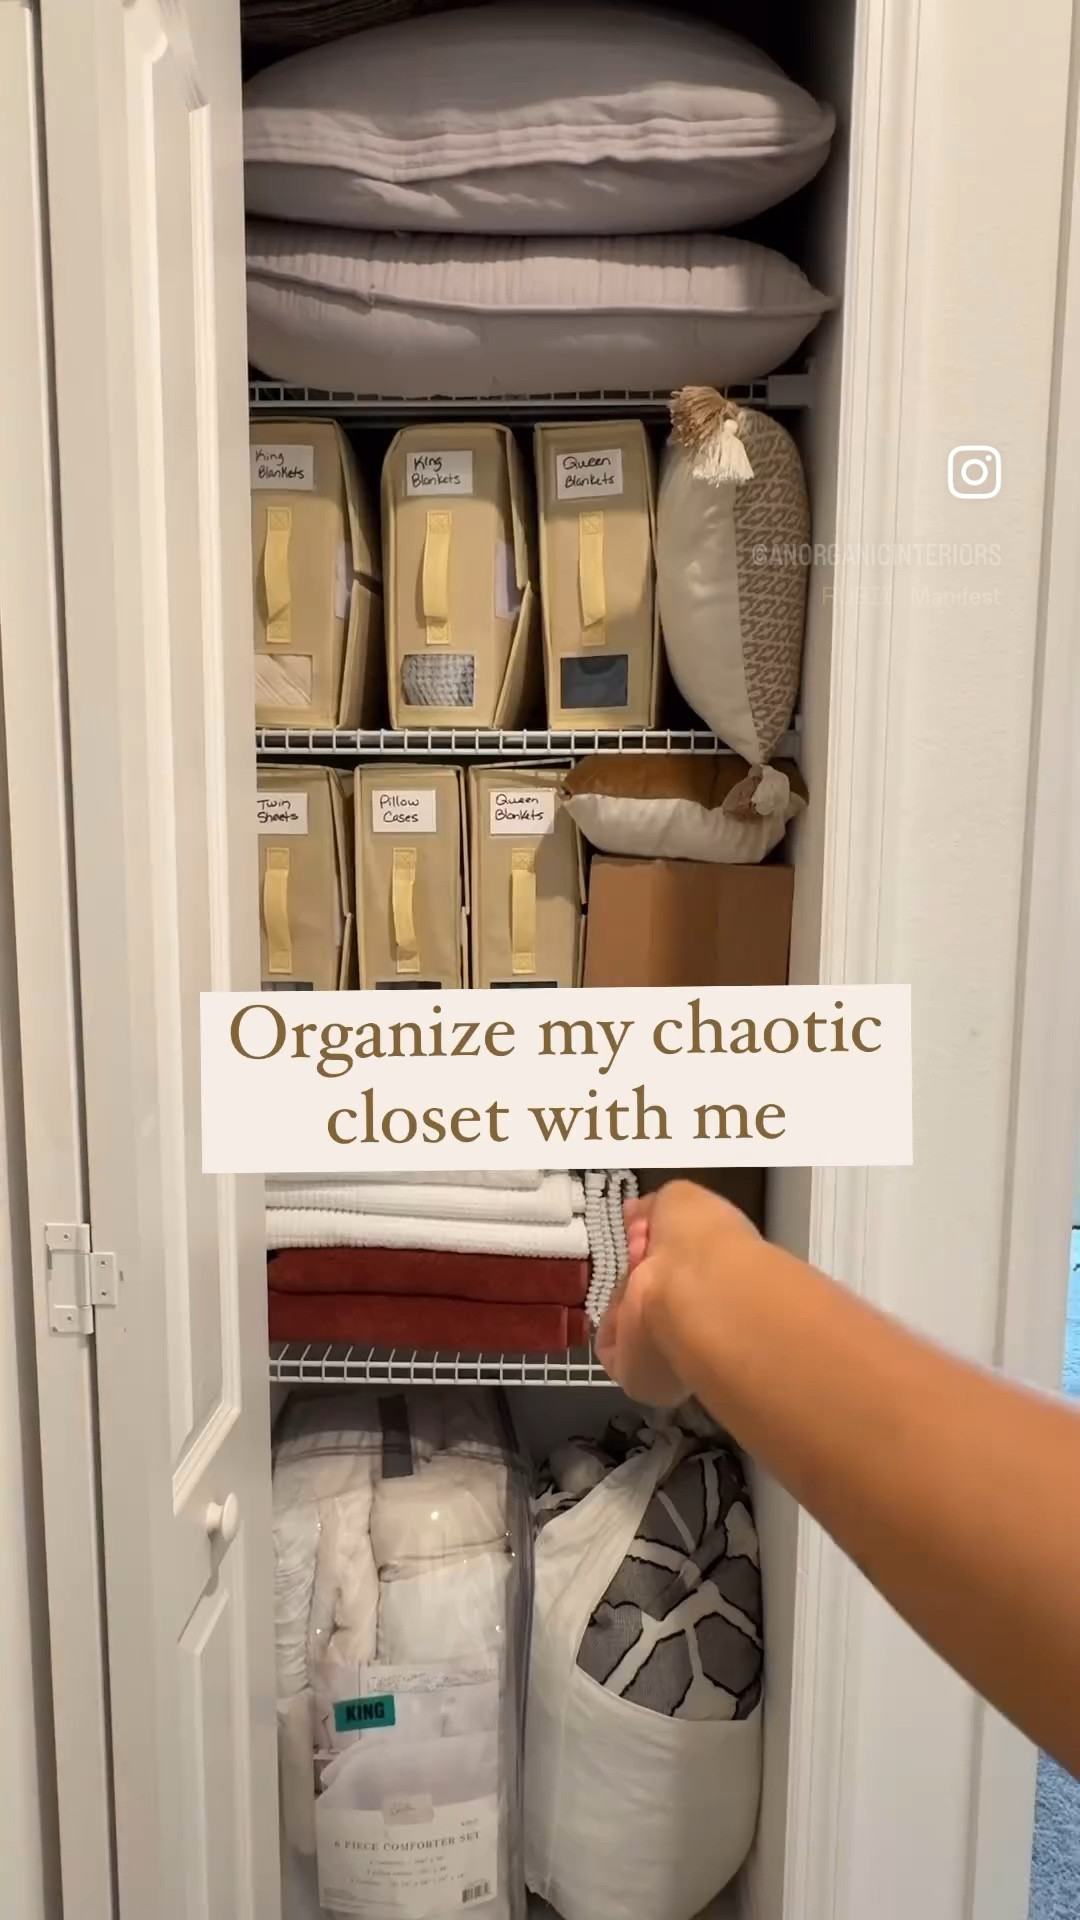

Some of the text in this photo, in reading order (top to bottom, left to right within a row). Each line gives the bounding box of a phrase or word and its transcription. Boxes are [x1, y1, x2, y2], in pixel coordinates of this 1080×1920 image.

[255, 448, 285, 467] King
[562, 455, 612, 471] Queen
[258, 465, 305, 480] Blankets
[411, 472, 461, 489] Blankets
[564, 474, 616, 489] Blankets
[256, 798, 292, 811] Twin
[379, 794, 421, 808] Pillow
[495, 793, 540, 806] Queen
[256, 811, 300, 825] Sheets
[382, 810, 420, 824] Cases
[494, 808, 545, 822] Blankets
[345, 1701, 386, 1721] KING
[344, 1841, 380, 1851] PIECE
[383, 1836, 456, 1852] COMFORTER
[459, 1831, 481, 1843] SET
